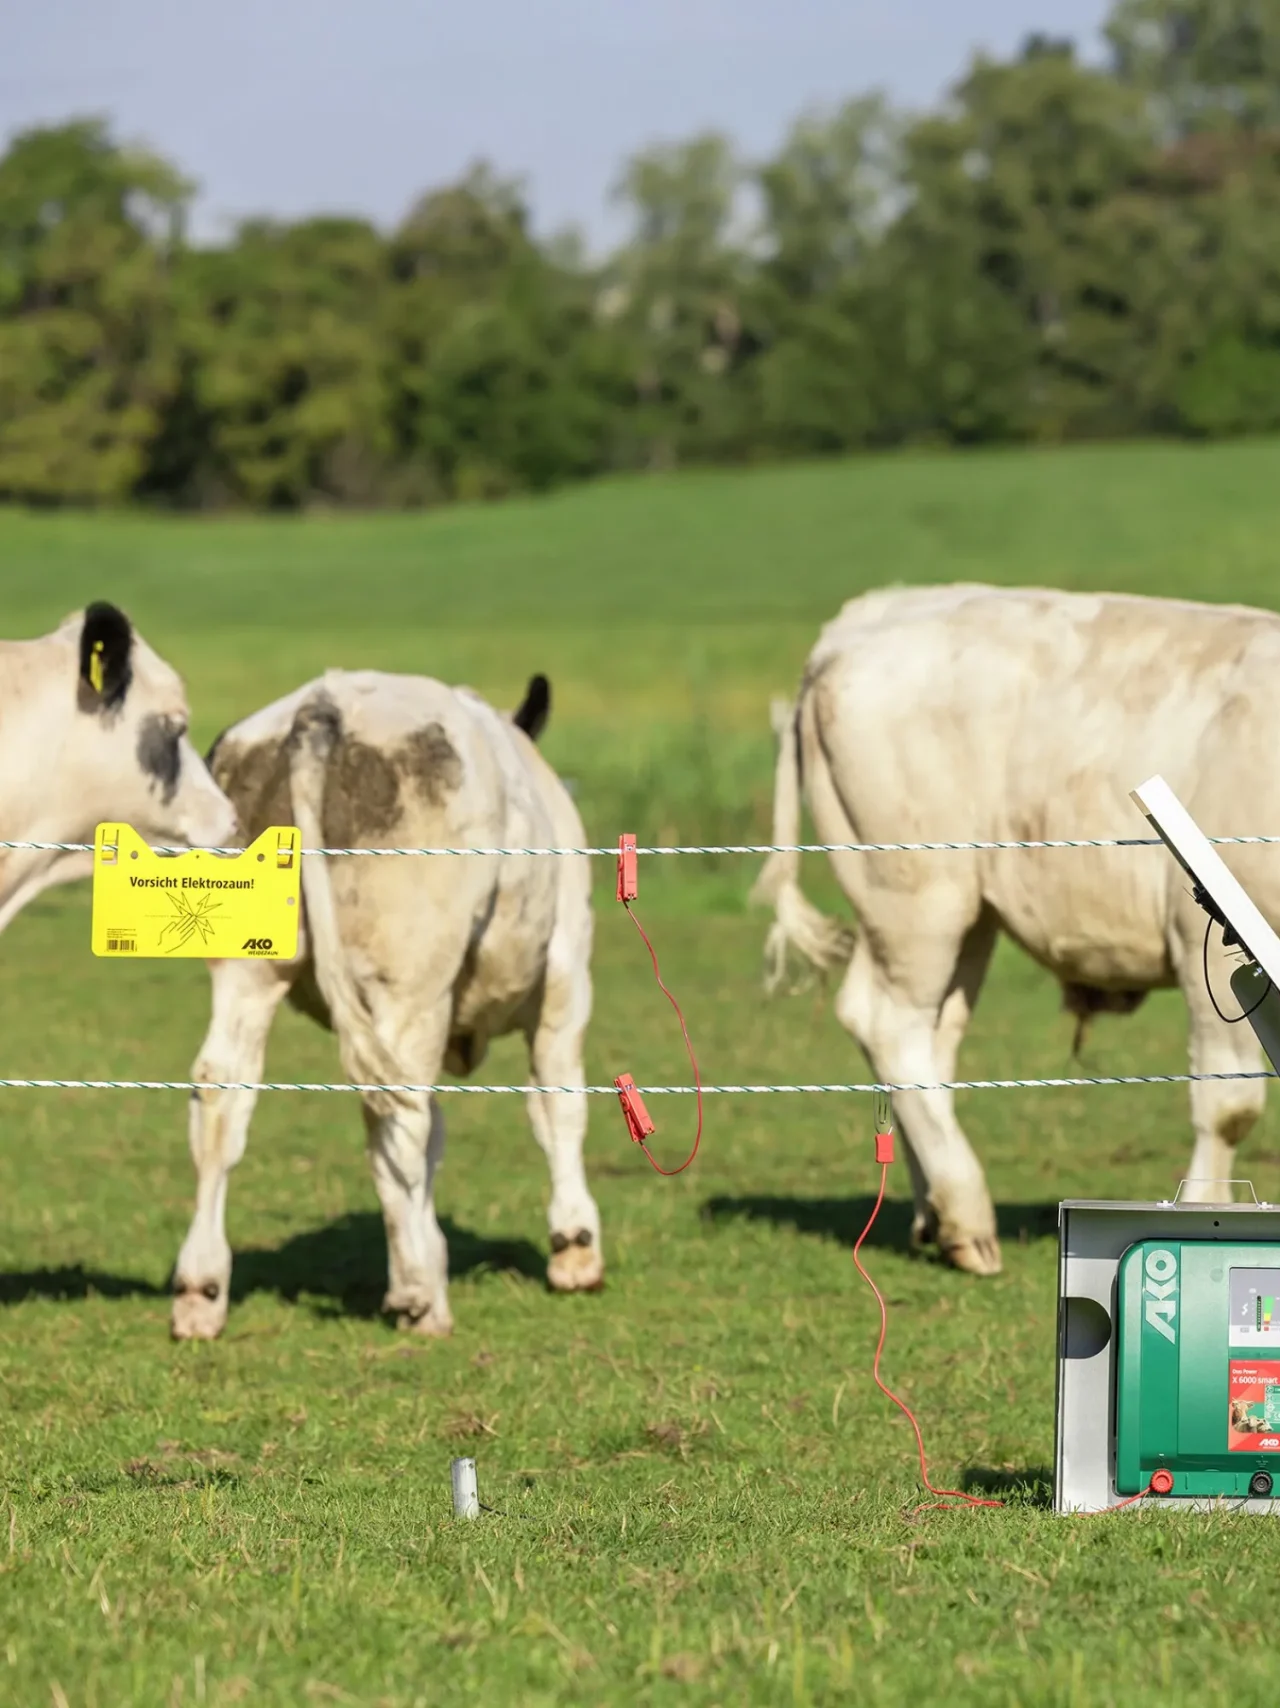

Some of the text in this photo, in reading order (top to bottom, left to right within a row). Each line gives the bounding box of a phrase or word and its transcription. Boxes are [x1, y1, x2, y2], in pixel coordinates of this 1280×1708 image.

[130, 876, 254, 890] Vorsicht Elektrozaun!
[242, 939, 273, 950] AKO
[1145, 1249, 1177, 1345] AKO
[1259, 1438, 1279, 1446] AKO
